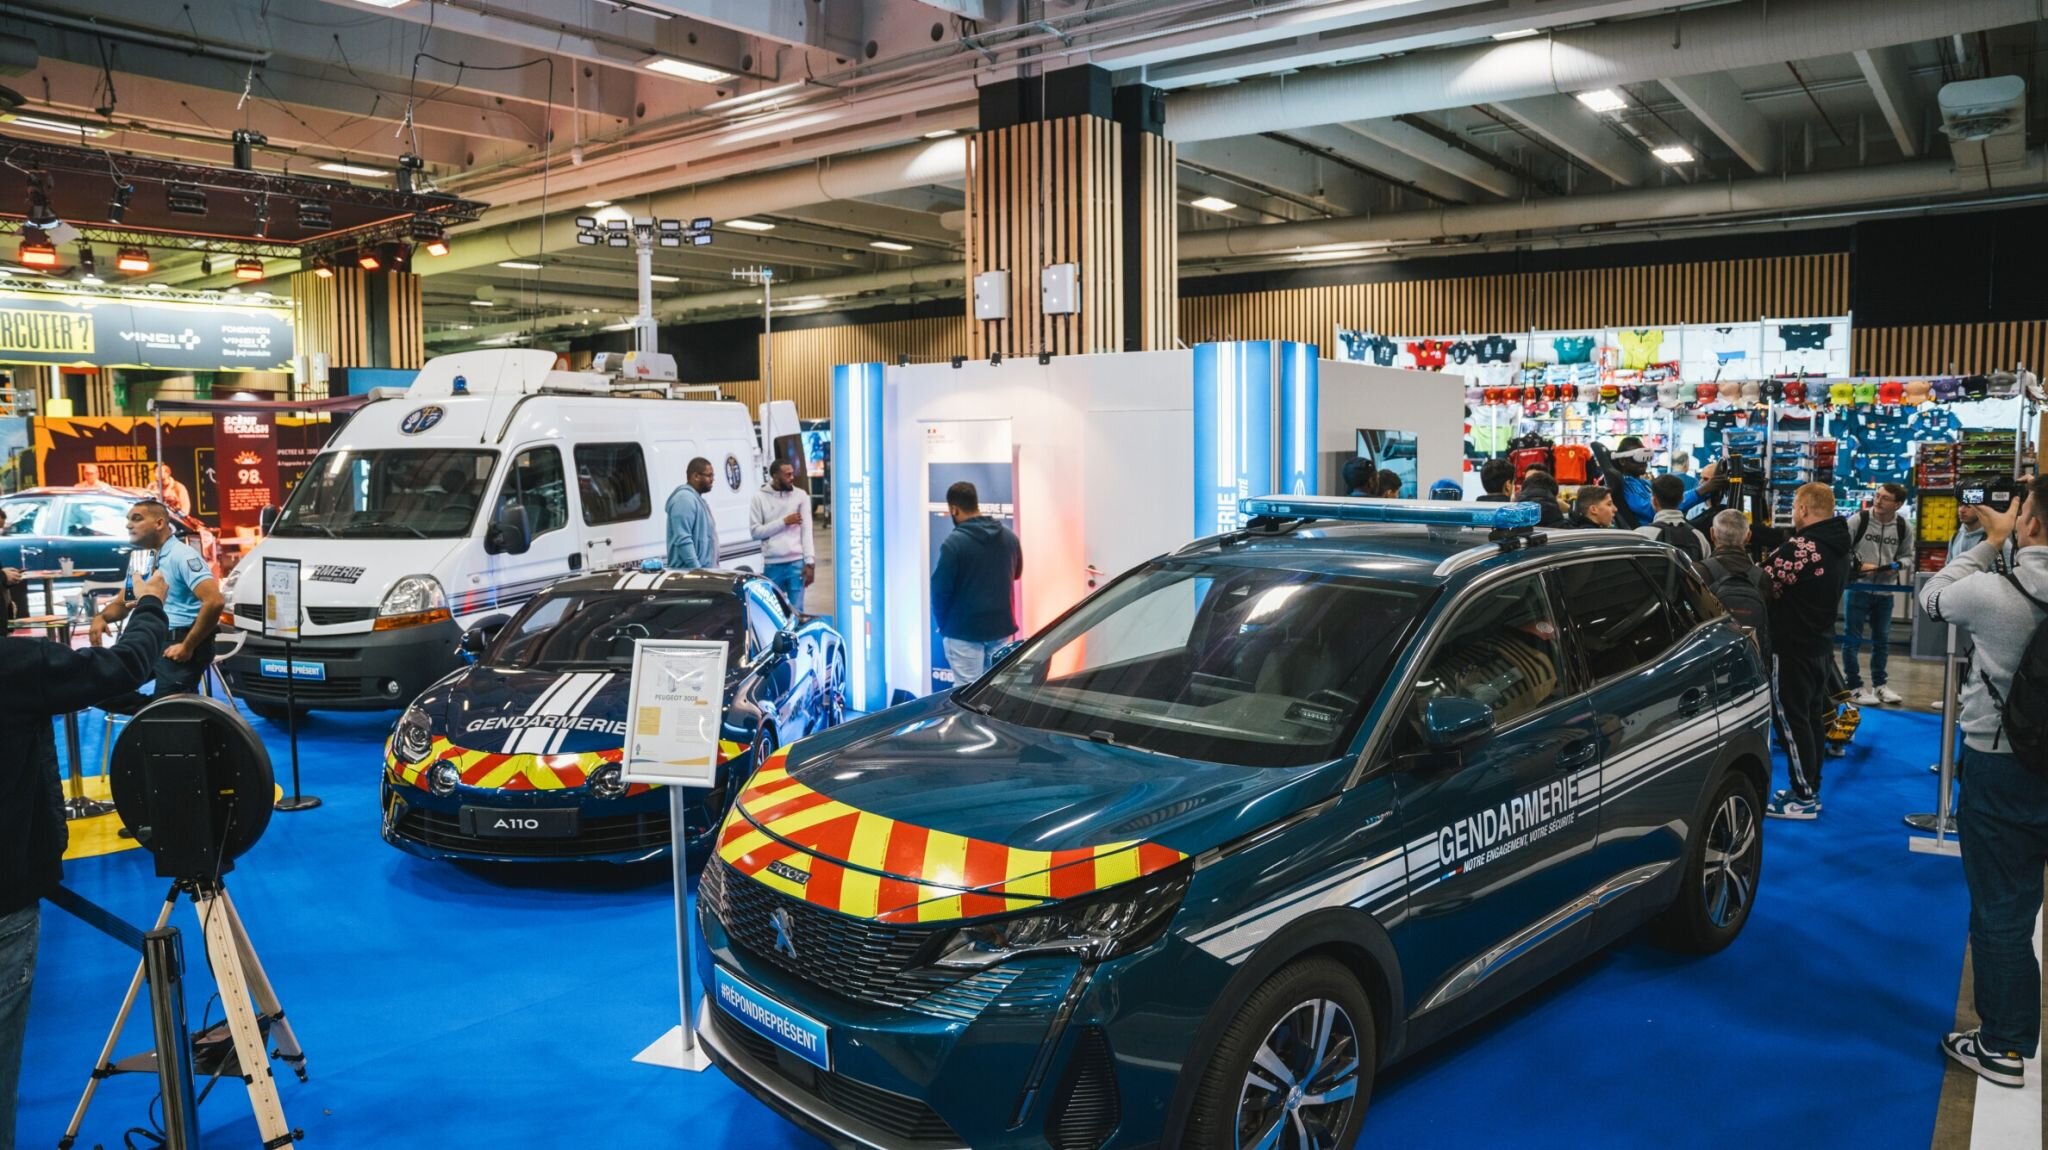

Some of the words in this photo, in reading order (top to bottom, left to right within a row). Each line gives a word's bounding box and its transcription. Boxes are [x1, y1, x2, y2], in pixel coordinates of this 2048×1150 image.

[119, 331, 176, 343] VINCI
[233, 424, 270, 434] CRASH
[850, 487, 864, 602] GENDARMERIE
[466, 715, 627, 736] GENDARMERIE
[493, 818, 539, 830] A110
[1439, 773, 1578, 866] GENDARMERIE
[1463, 852, 1485, 874] NOTRE
[1486, 835, 1529, 862] ENGAGEMENT,
[1529, 826, 1549, 843] VOTRE
[1548, 811, 1575, 834] SÉCURITÉ
[720, 982, 818, 1053] #RÉPONDREPRÉSENT
